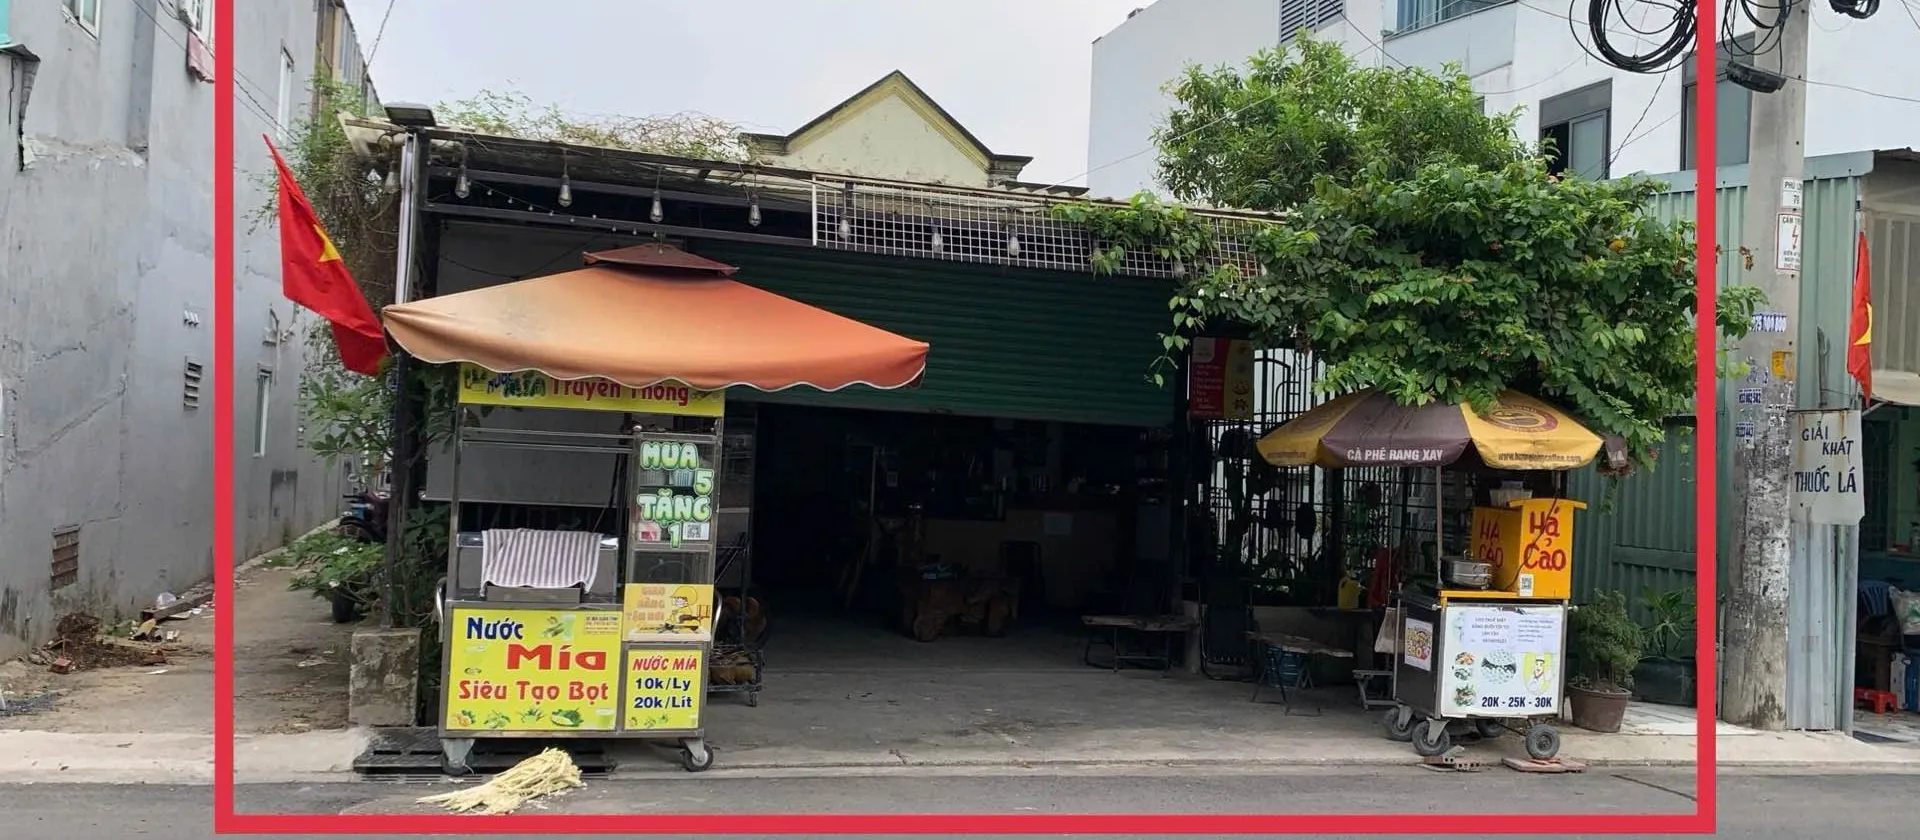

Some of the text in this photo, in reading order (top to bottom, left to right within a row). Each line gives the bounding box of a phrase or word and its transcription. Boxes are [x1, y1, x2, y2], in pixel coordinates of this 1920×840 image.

[1802, 421, 1828, 441] GIẢI
[1347, 448, 1443, 461] CÀ PHÊ RANG XAY
[1822, 436, 1854, 457] KHÁT
[641, 442, 714, 495] MUA 5
[1795, 465, 1857, 493] THUỐC LÁ
[637, 488, 712, 549] TẶNG 1
[1529, 506, 1560, 537] Há
[1523, 537, 1566, 572] Cảo
[467, 617, 524, 640] Nước
[507, 644, 606, 670] Mía
[632, 655, 697, 671] NƯỚC MÍA
[458, 680, 609, 705] Siêu Tạo Bọt
[636, 677, 691, 691] 10k/Ly
[634, 696, 692, 709] 20k/Lít
[1482, 696, 1499, 708] 20K
[1508, 696, 1526, 708] 25K
[1534, 696, 1552, 708] 30K
